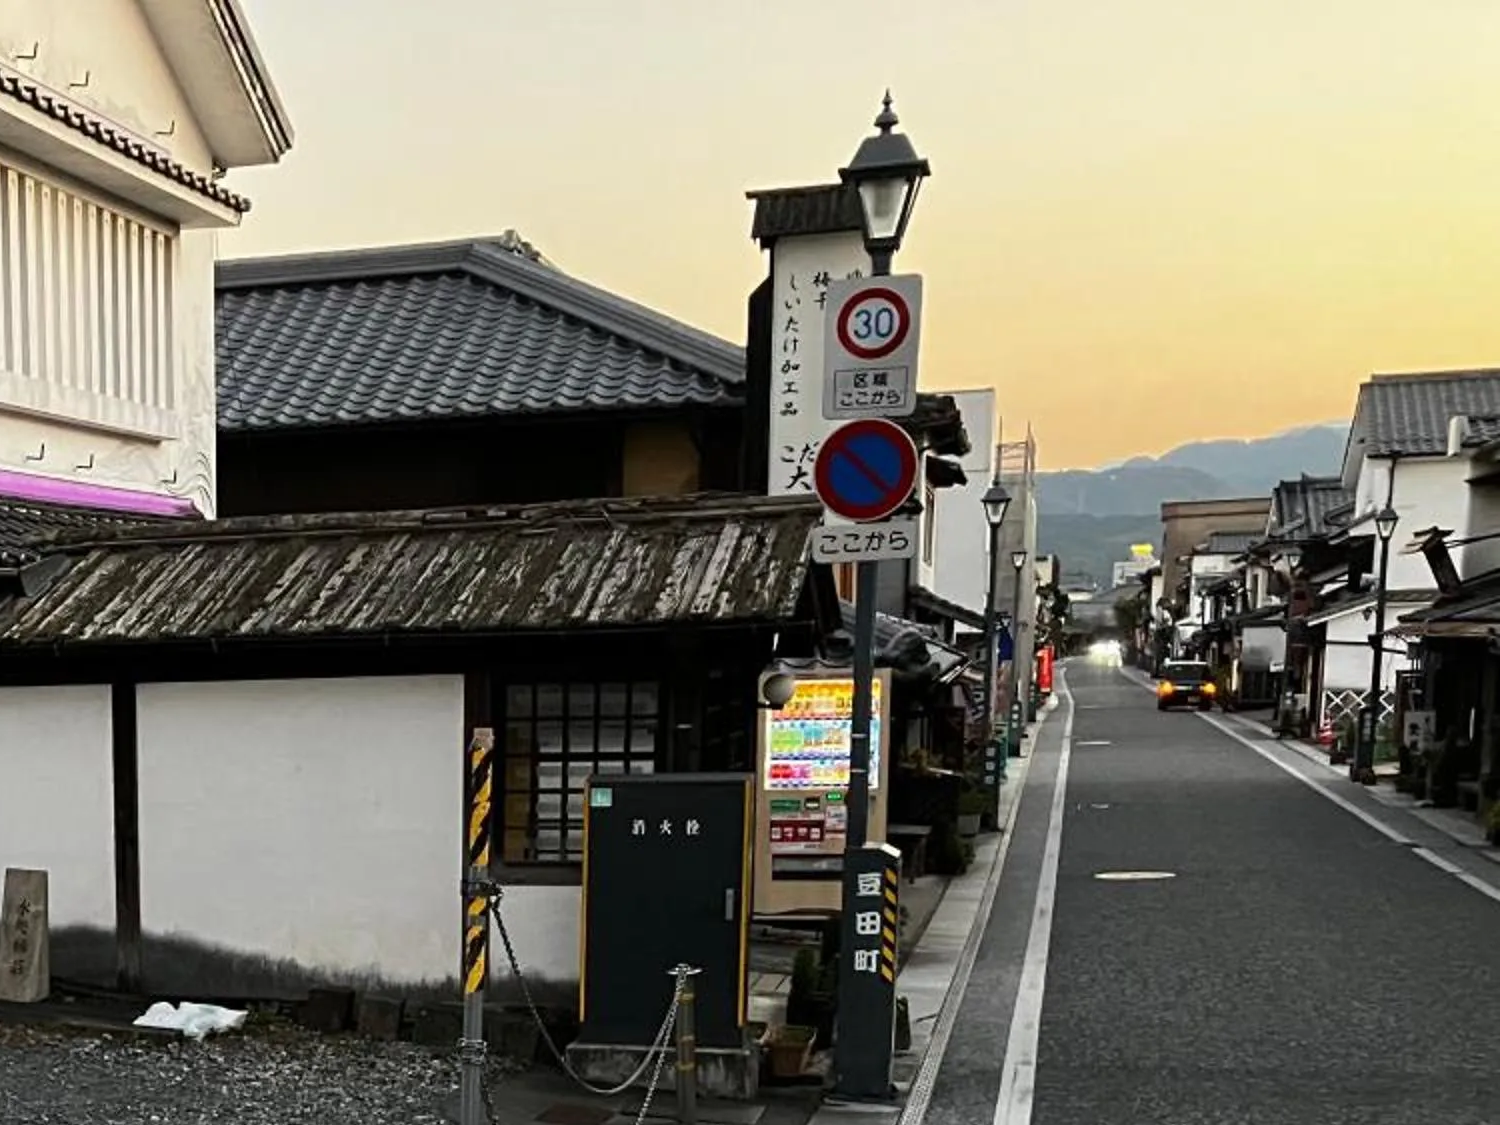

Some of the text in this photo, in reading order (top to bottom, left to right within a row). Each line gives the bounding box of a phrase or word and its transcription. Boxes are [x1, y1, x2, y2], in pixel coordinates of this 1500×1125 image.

[853, 307, 894, 339] 30
[780, 274, 801, 416] しいたけ加工品
[840, 389, 901, 407] ここから
[819, 530, 909, 555] ここから
[631, 818, 700, 836] 消火栓
[854, 872, 882, 973] 豆田町
